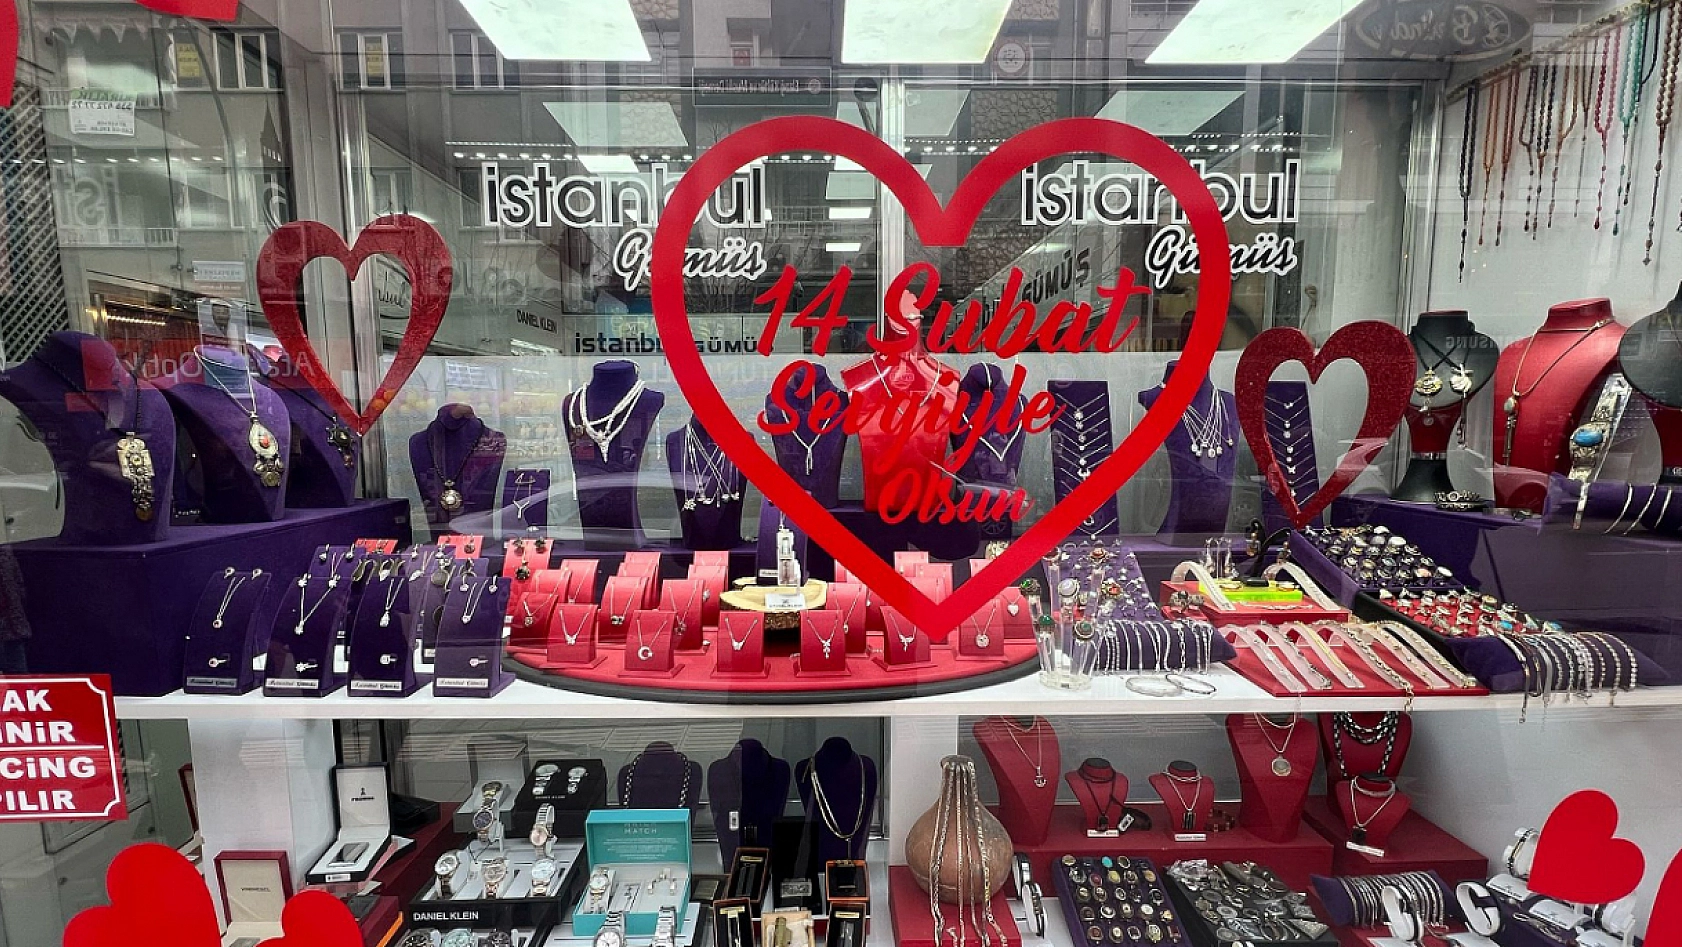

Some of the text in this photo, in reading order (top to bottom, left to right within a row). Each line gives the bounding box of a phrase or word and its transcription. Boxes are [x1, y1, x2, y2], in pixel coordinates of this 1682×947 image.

[754, 263, 852, 357] 14
[757, 359, 1066, 472] Sevgiyle
[878, 466, 1038, 525] Olsun
[412, 911, 479, 921] DANIEL KLEIN
